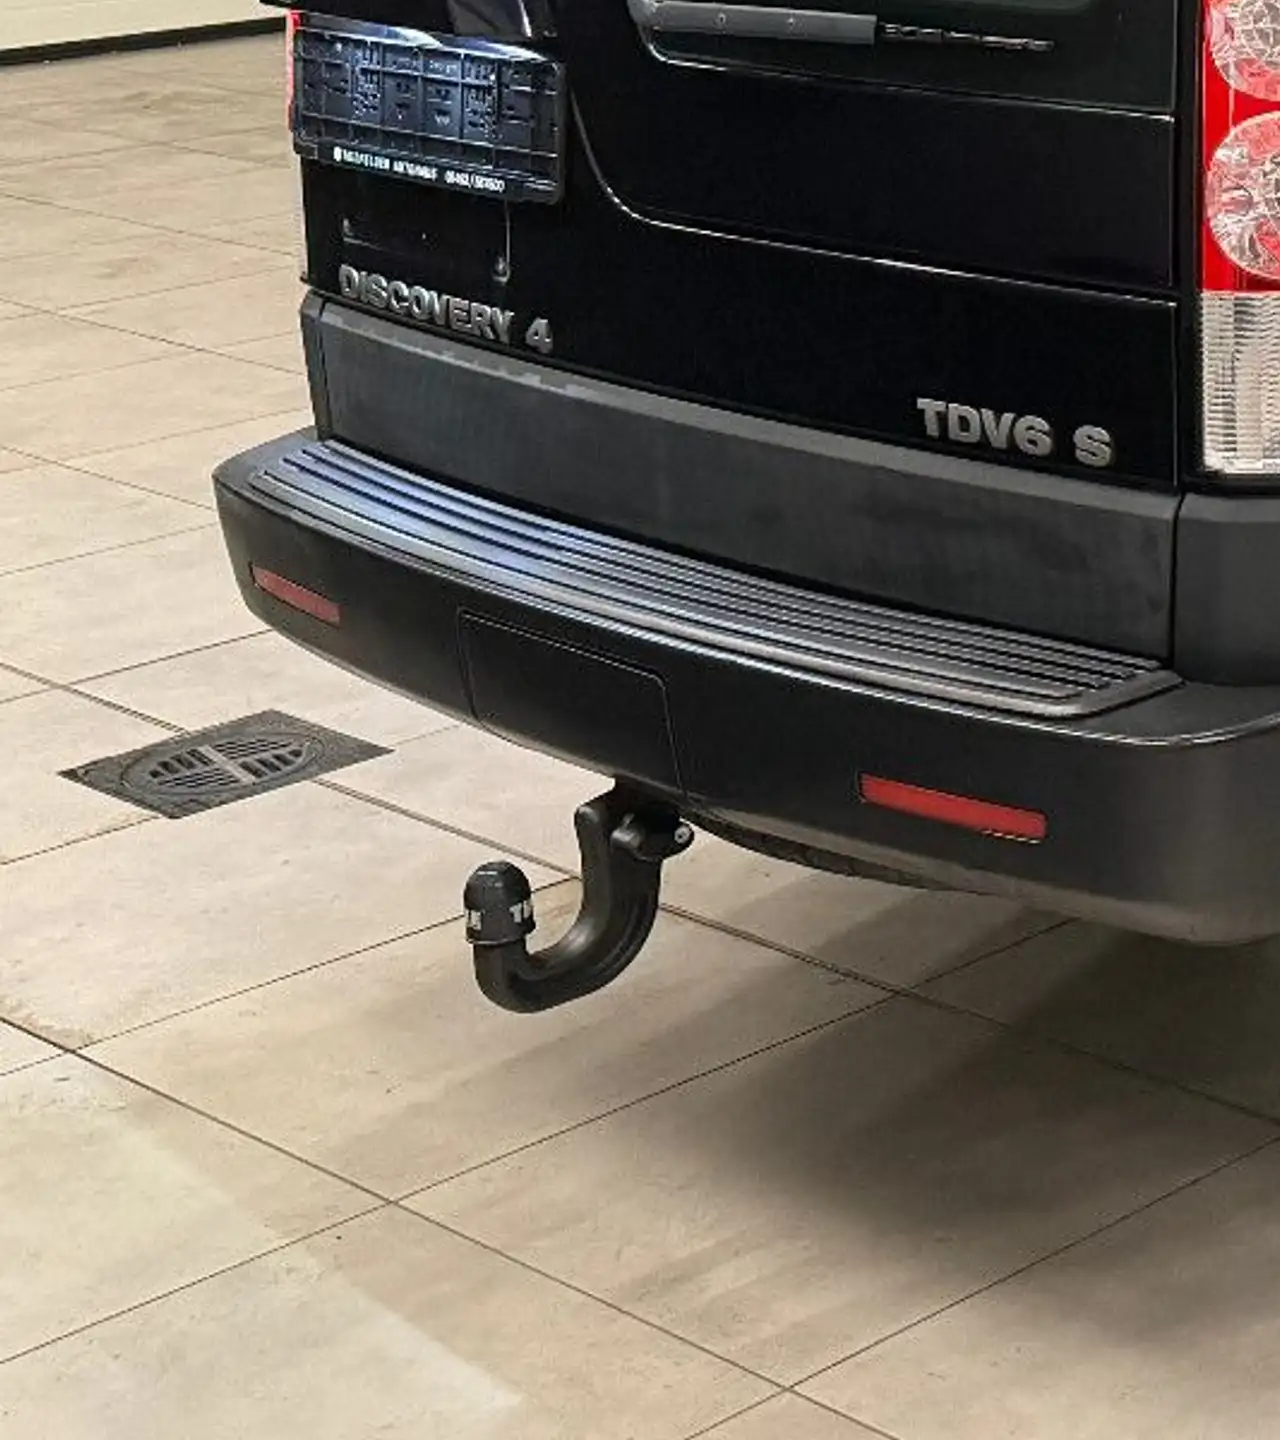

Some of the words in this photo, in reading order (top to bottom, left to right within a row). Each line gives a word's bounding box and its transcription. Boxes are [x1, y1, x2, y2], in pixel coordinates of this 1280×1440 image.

[338, 263, 514, 343] DISCOVERY
[525, 317, 552, 354] 4
[916, 397, 1053, 457] TDV6
[1073, 424, 1113, 468] S
